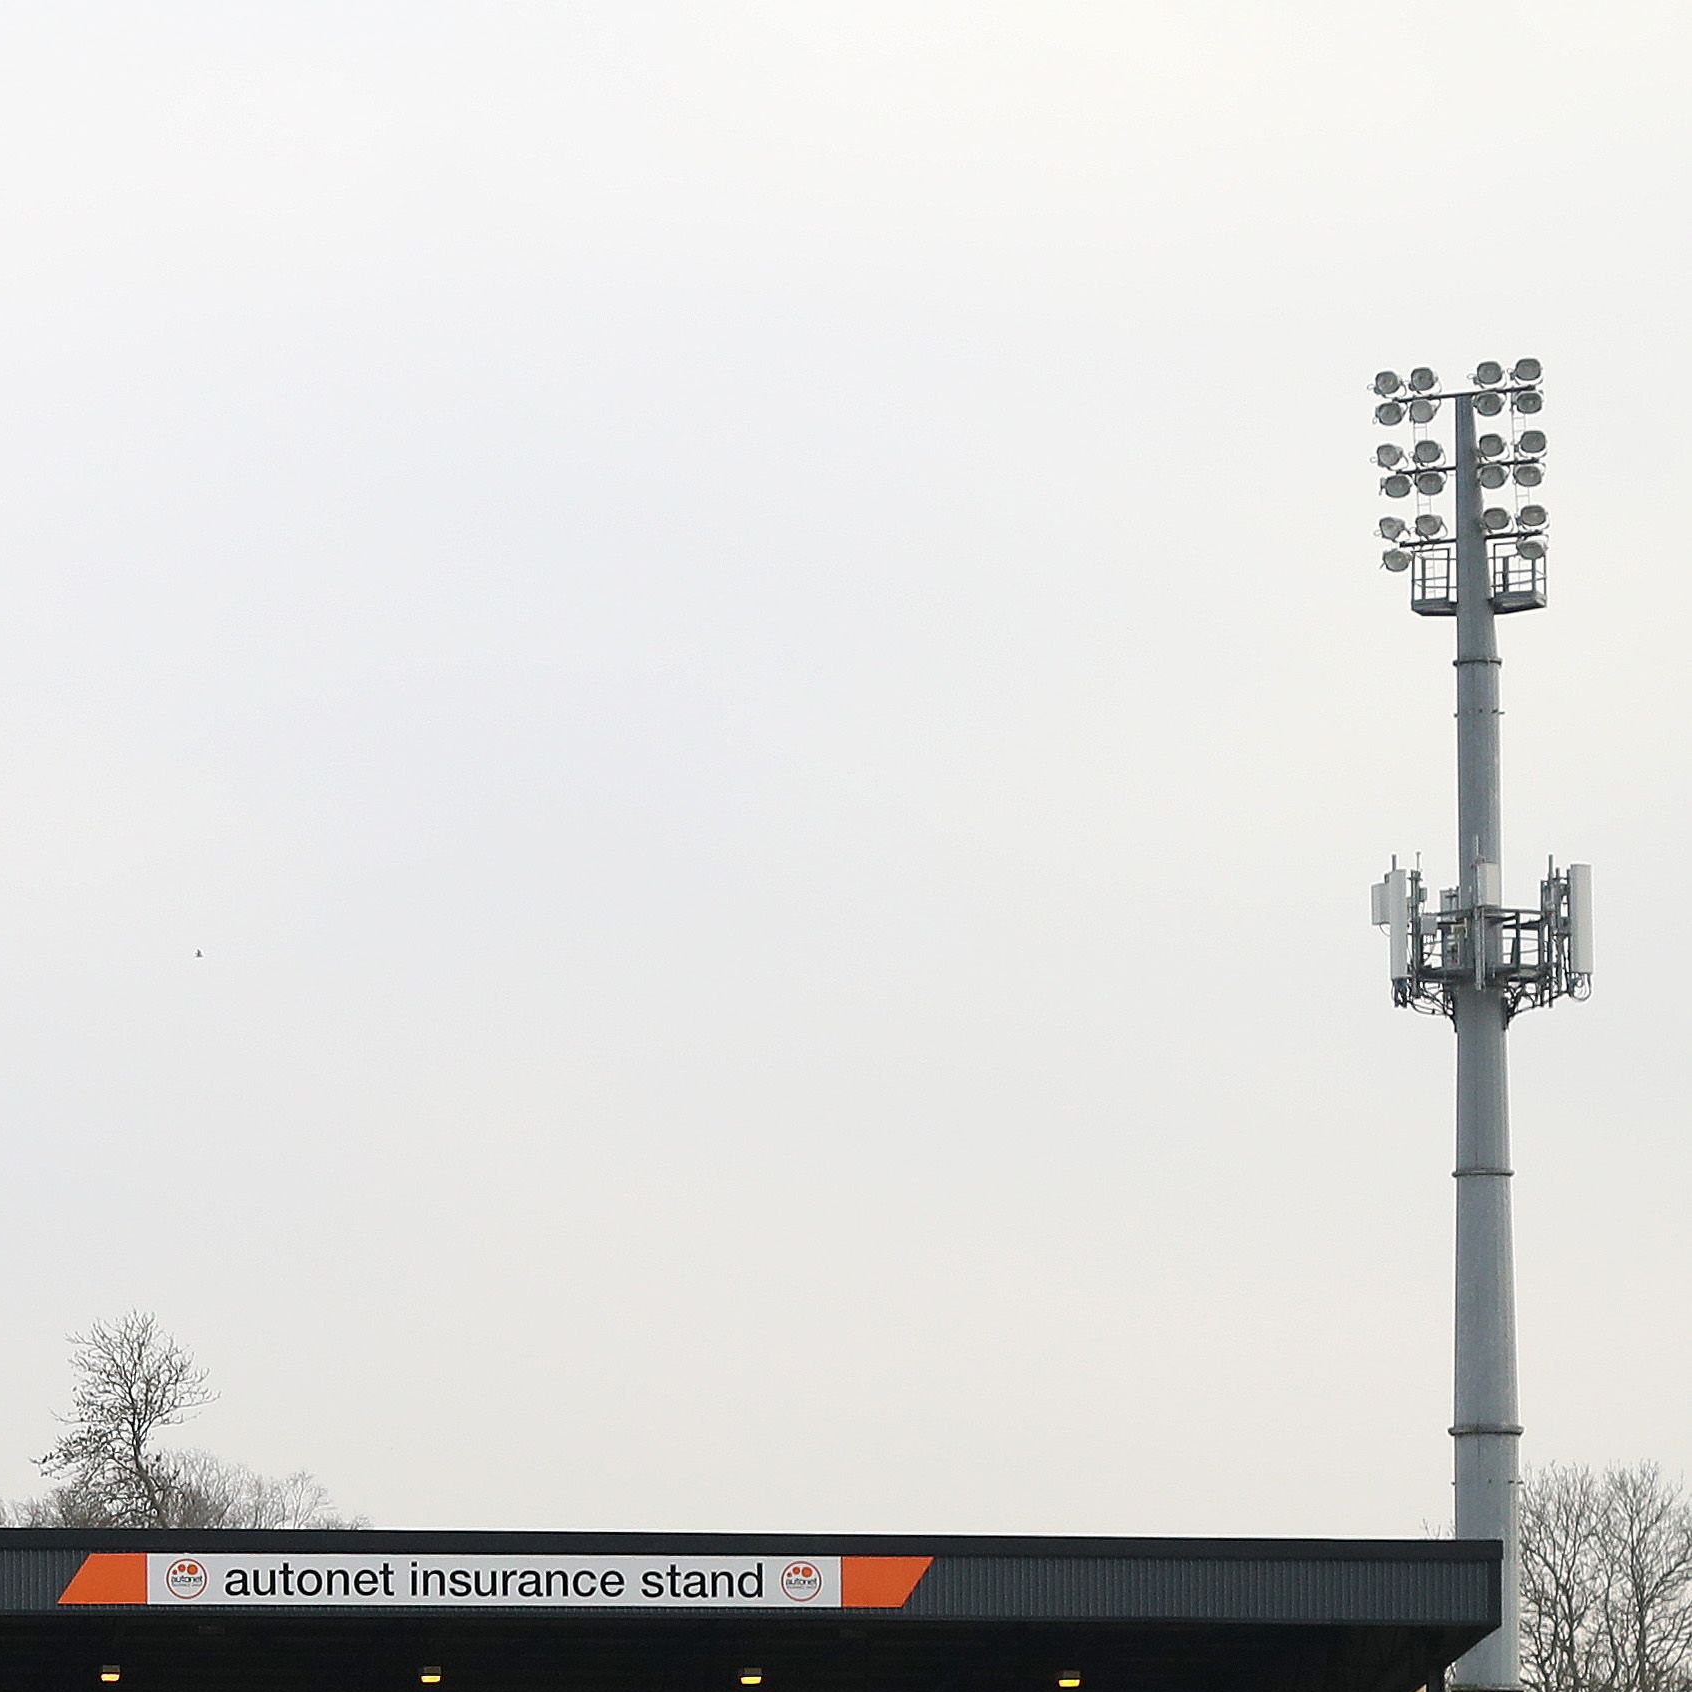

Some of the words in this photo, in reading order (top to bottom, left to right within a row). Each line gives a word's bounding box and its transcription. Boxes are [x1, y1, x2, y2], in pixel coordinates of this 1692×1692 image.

[225, 1562, 395, 1597] autonet
[411, 1561, 625, 1597] insurance
[641, 1562, 764, 1599] stand
